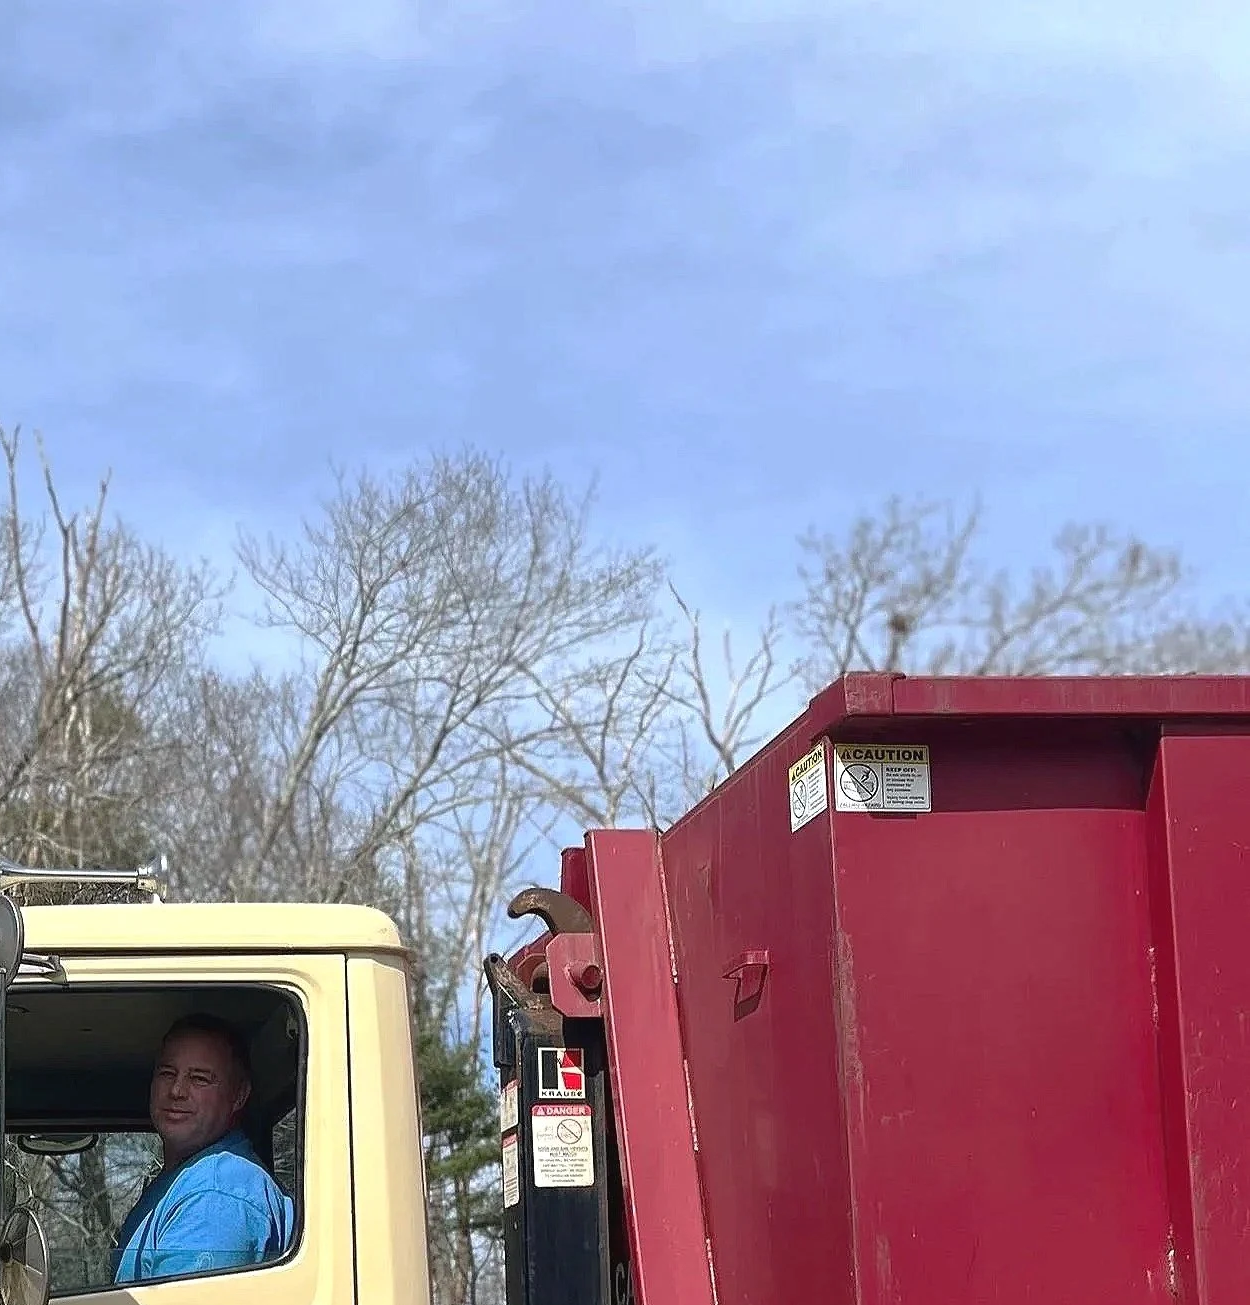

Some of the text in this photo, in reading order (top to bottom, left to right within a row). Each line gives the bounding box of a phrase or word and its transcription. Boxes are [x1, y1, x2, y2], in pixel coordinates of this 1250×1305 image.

[853, 749, 924, 760] CAUTION
[795, 749, 823, 777] CAUTION
[546, 1107, 586, 1115] DANGER
